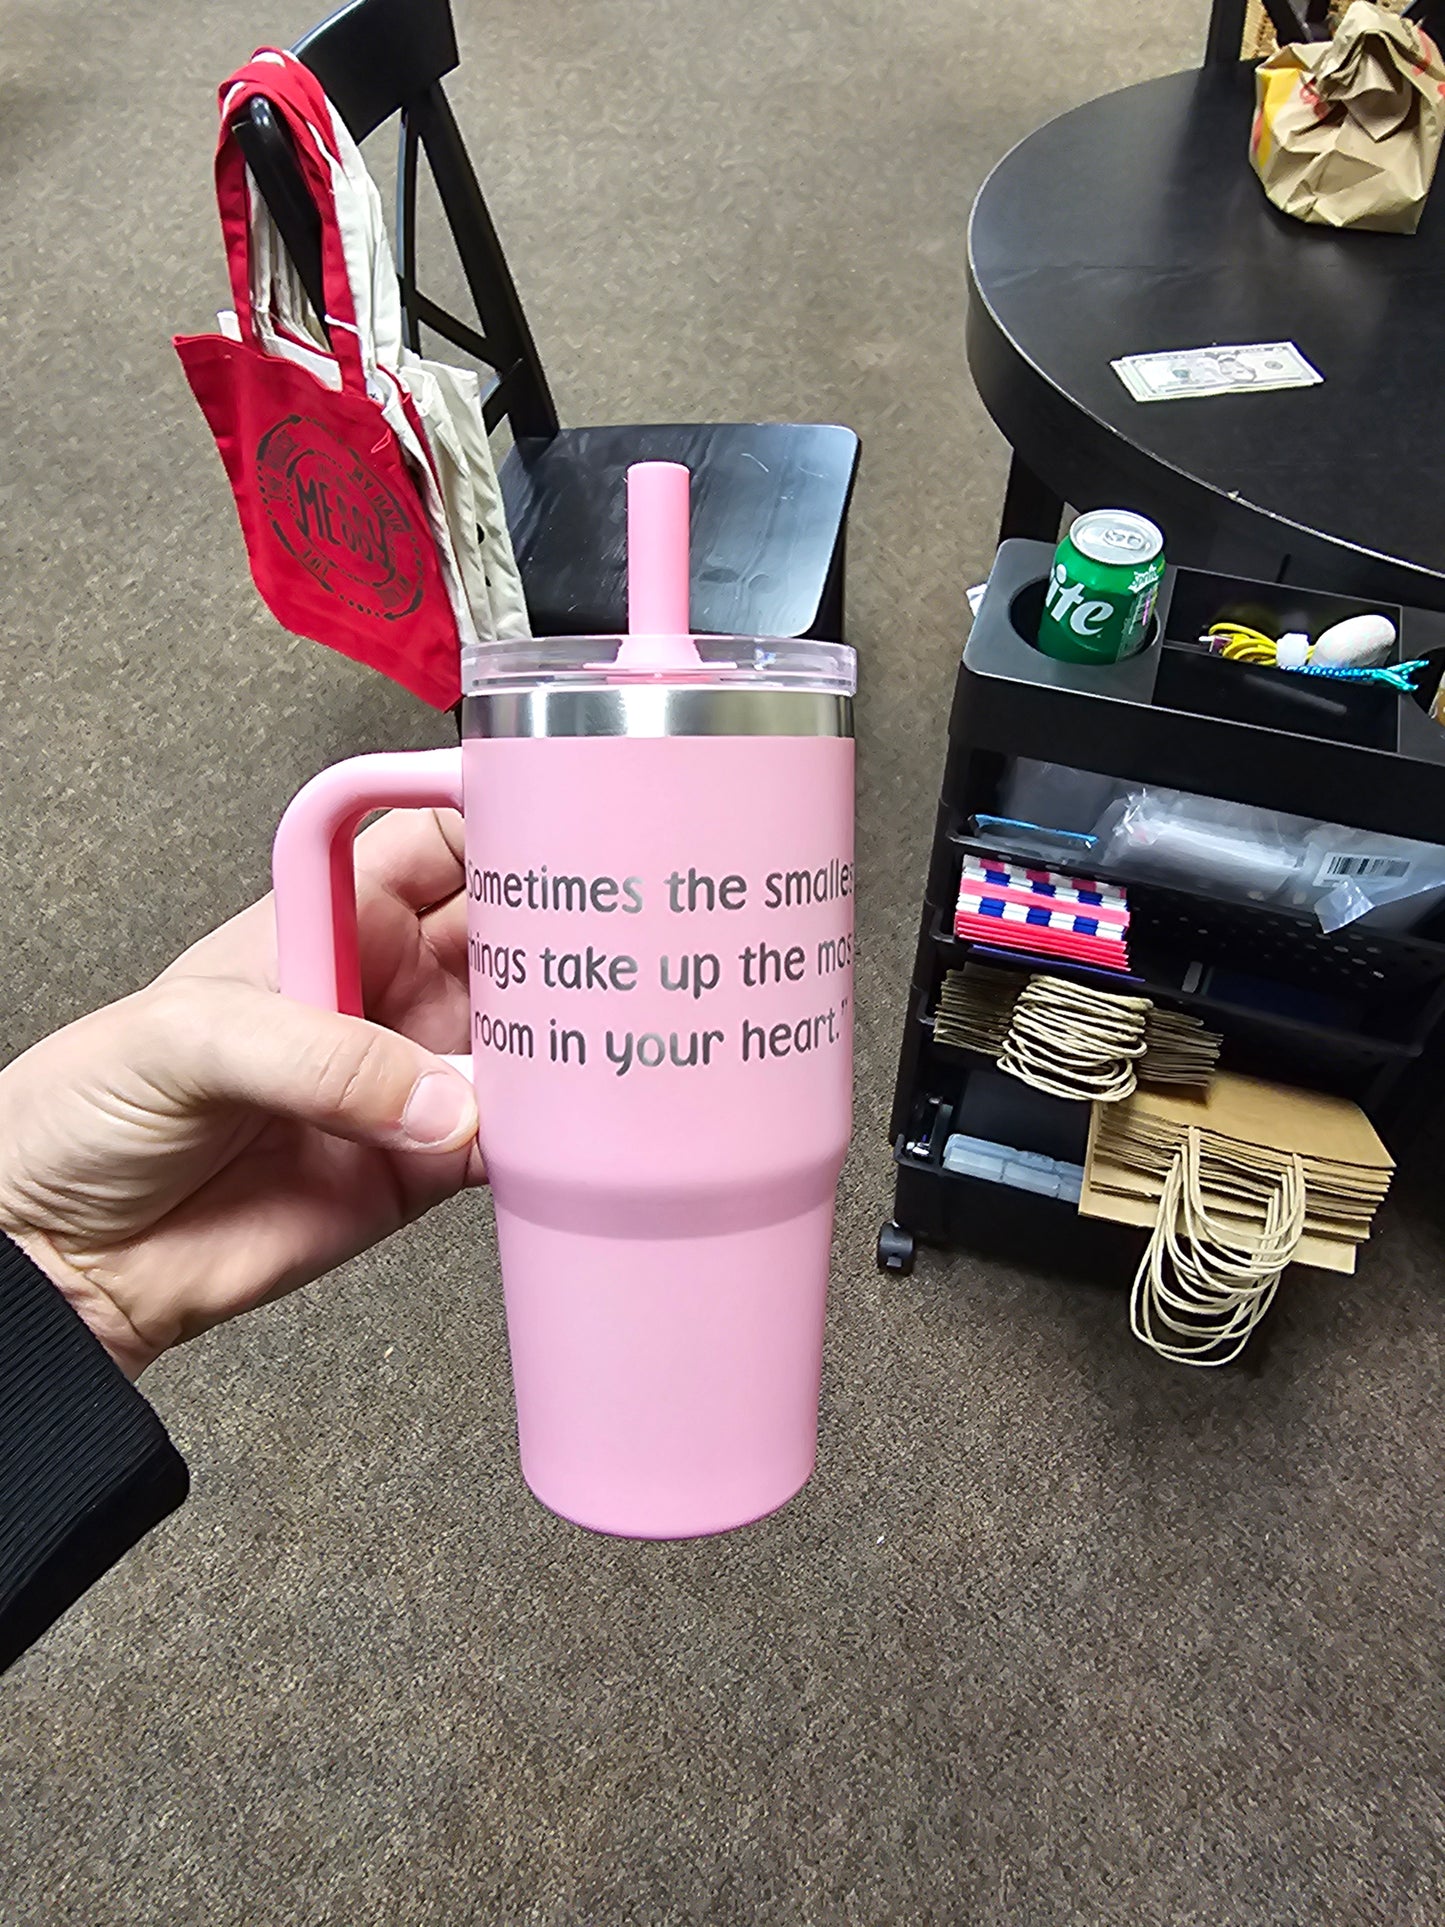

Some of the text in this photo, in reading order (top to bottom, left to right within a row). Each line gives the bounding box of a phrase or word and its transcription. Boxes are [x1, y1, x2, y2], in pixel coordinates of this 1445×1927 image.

[1045, 563, 1115, 636] ite
[664, 867, 747, 913] the
[468, 931, 527, 990] hings
[539, 945, 639, 991] take
[660, 953, 721, 1000] up
[738, 942, 806, 987] the
[475, 997, 849, 1076] room in your heart."
